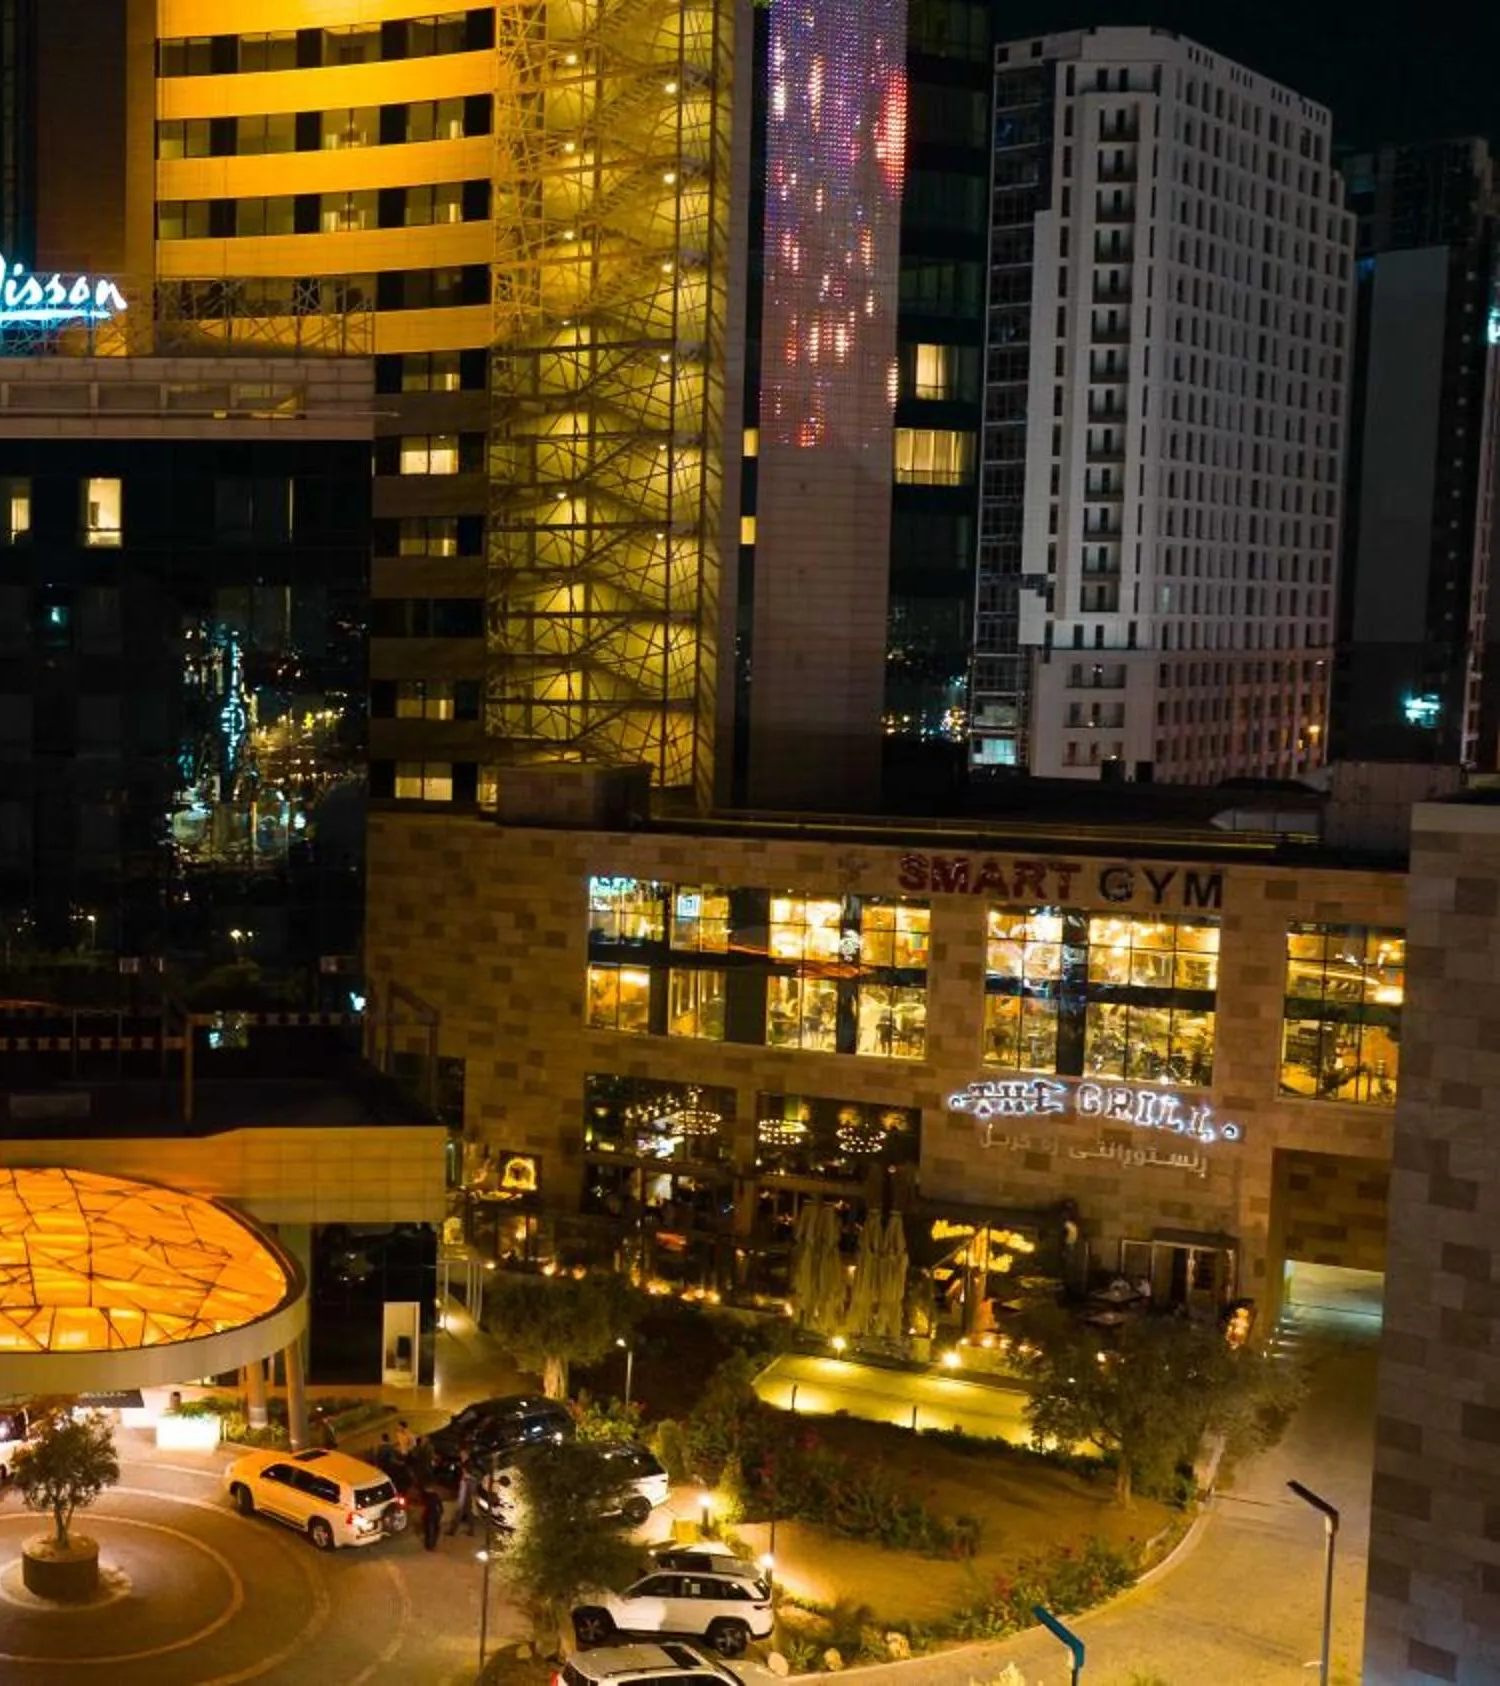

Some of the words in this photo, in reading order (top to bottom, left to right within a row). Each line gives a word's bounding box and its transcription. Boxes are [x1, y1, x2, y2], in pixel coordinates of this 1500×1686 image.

[898, 852, 1082, 901] SMART
[1097, 866, 1224, 909] GYM
[966, 1079, 1068, 1117] THE
[1076, 1082, 1216, 1143] GRILL
